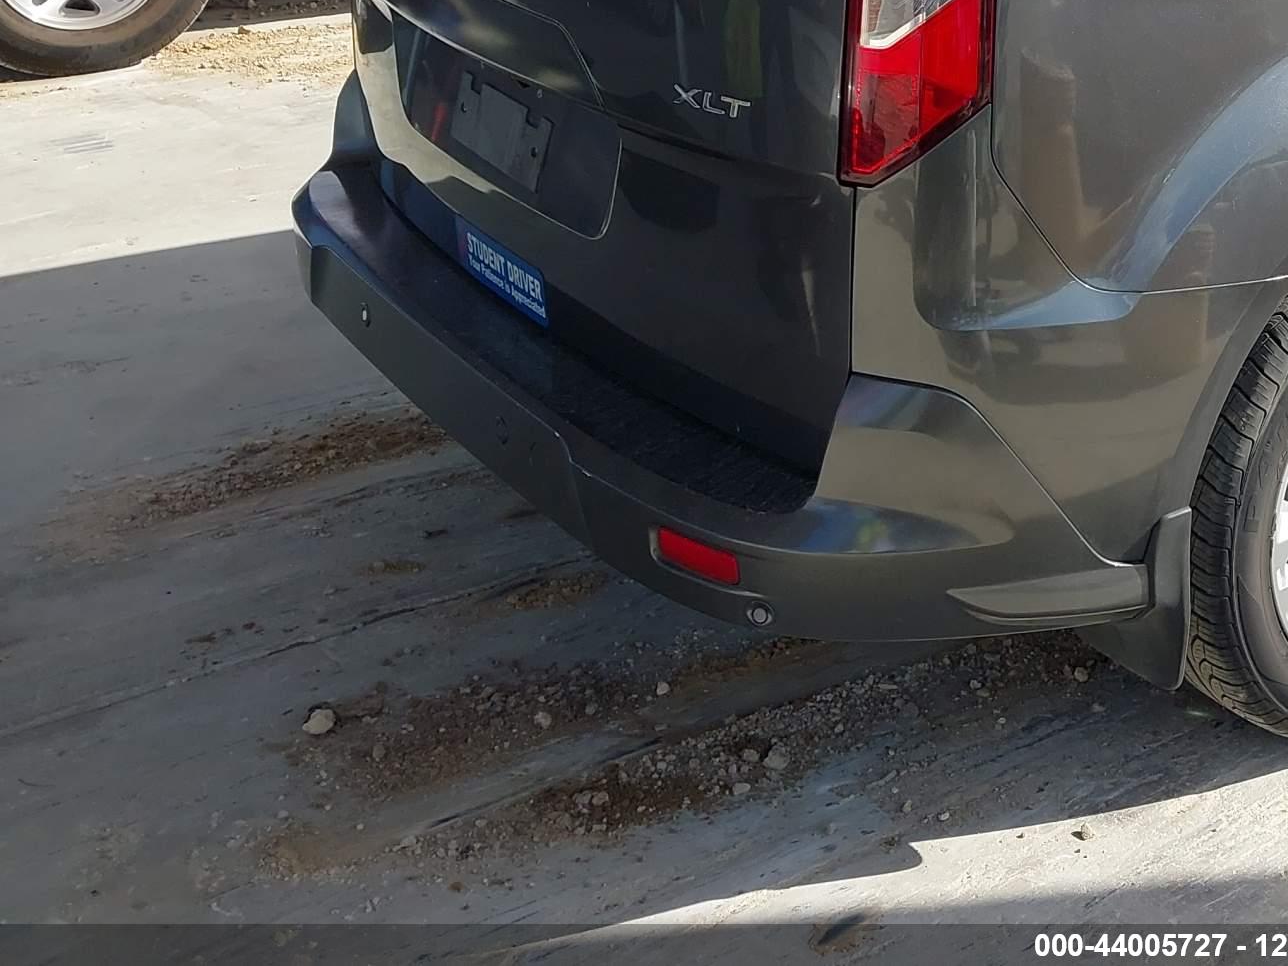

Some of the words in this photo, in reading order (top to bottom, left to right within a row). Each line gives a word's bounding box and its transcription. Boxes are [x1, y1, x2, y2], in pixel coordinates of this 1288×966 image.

[673, 83, 752, 119] XLT
[466, 231, 505, 276] STUDENT
[506, 260, 543, 302] DRIVER
